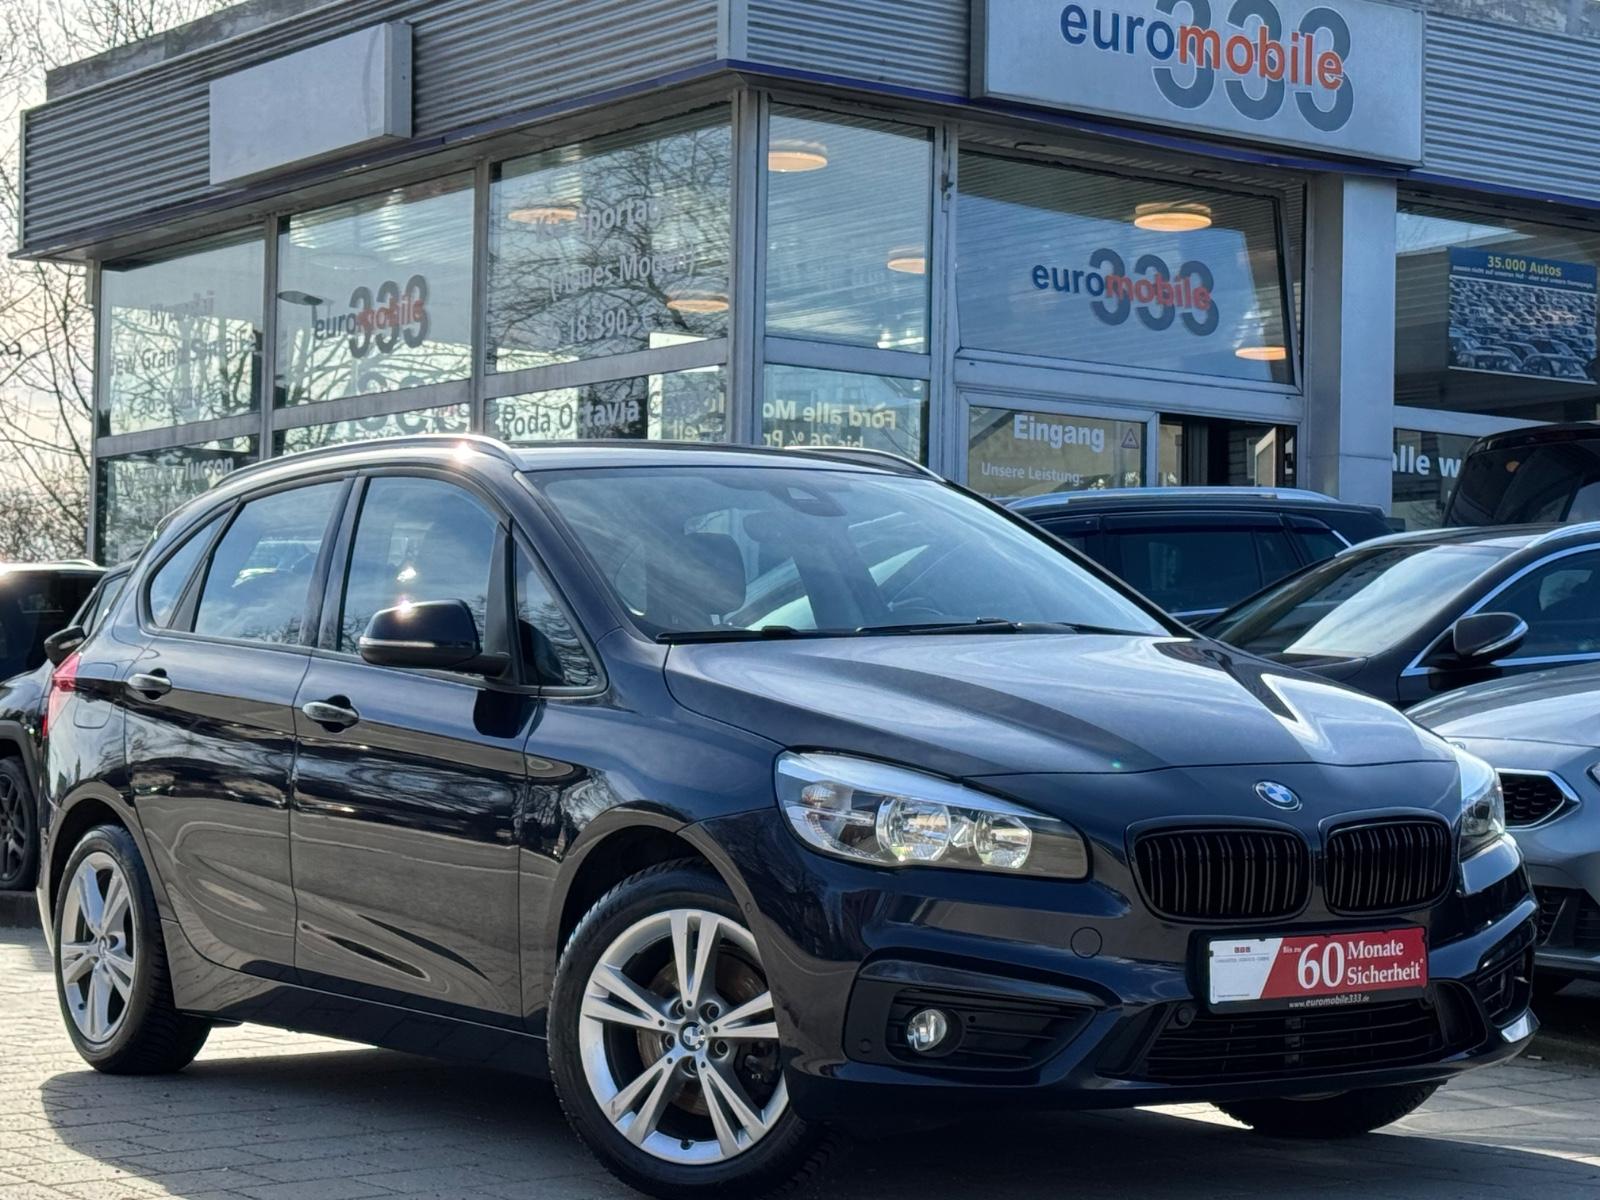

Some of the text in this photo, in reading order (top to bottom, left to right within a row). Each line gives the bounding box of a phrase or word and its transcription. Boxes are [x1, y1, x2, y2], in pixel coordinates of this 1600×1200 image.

[1060, 3, 1344, 91] euromobile
[1487, 255, 1562, 276] 35.000 Autos
[1031, 263, 1213, 311] euromobile
[1014, 414, 1105, 453] Eingang
[182, 457, 235, 482] Tucson
[981, 461, 1084, 487] Unsere Leistung:
[1297, 941, 1345, 989] 60
[1347, 939, 1404, 960] Monate
